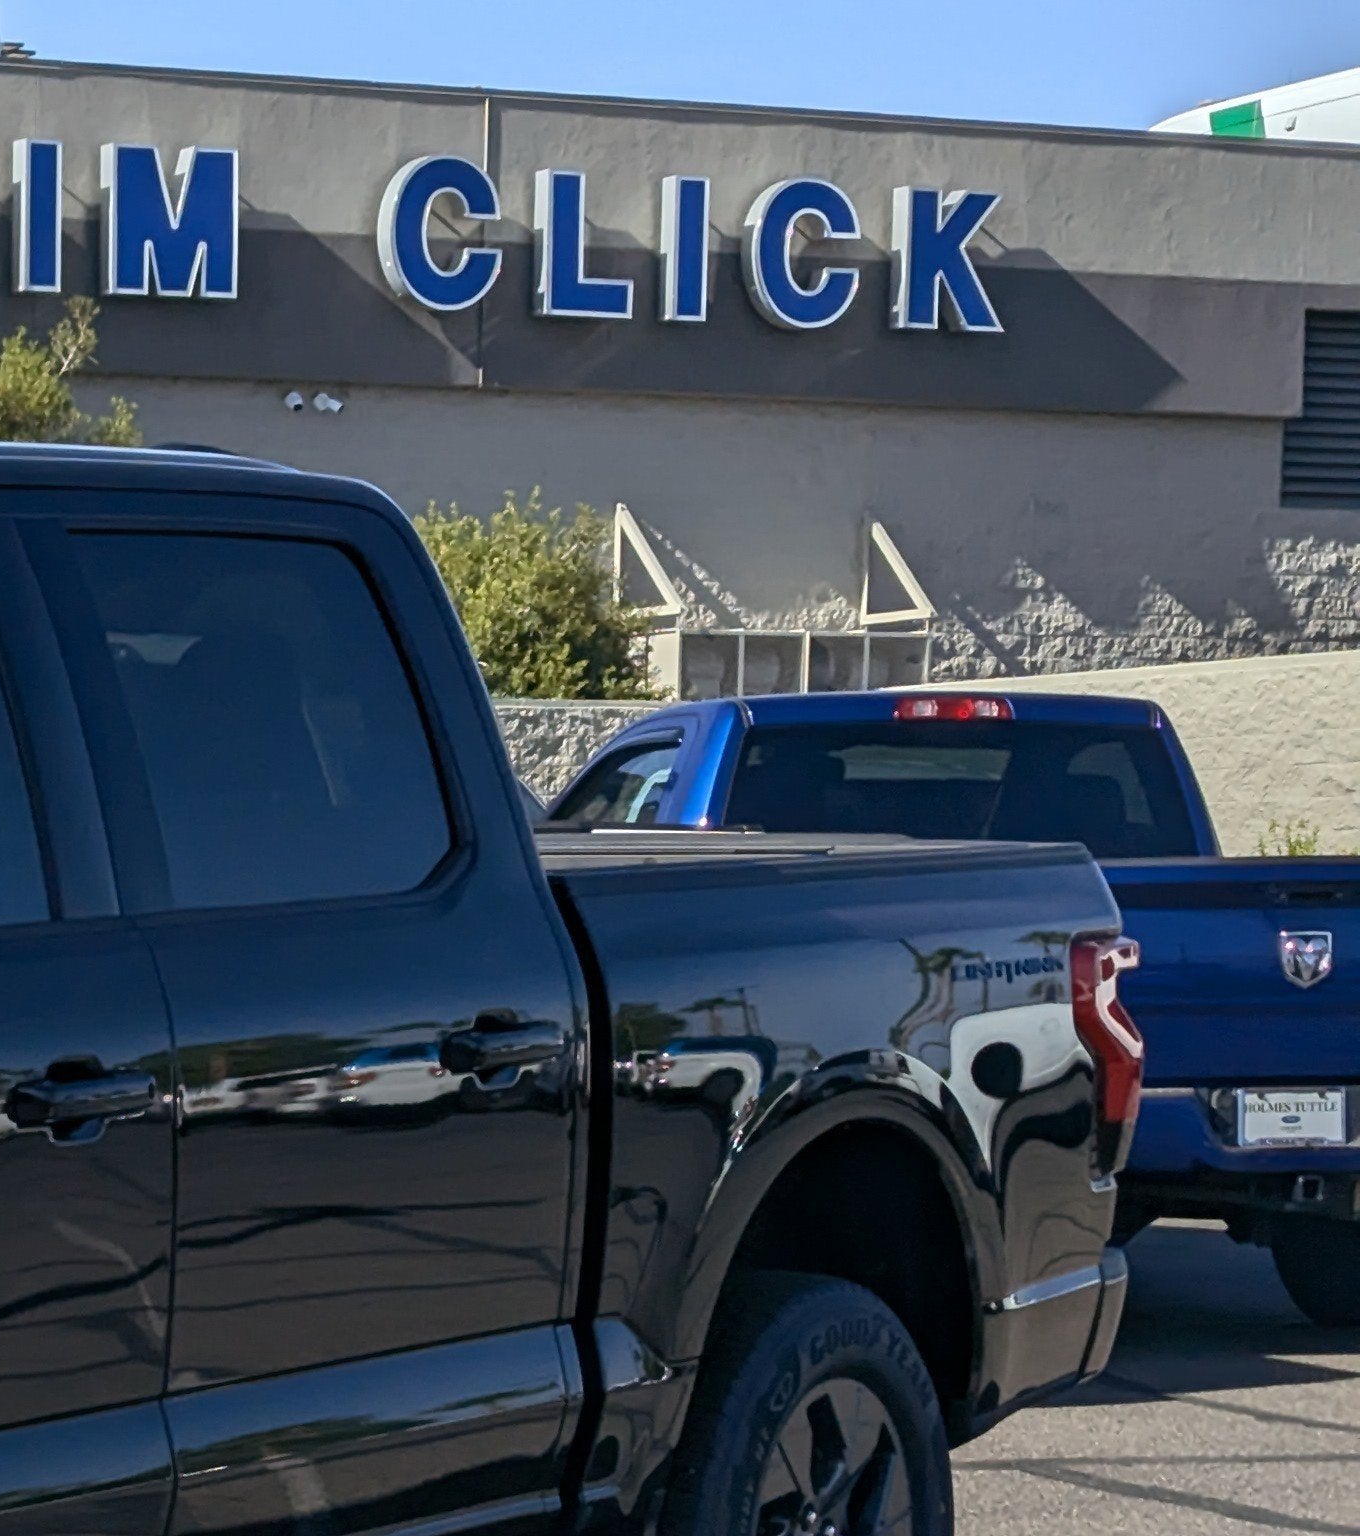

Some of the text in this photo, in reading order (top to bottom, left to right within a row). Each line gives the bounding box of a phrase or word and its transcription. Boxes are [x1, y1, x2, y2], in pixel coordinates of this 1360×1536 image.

[377, 154, 1006, 334] CLICK
[1245, 1101, 1338, 1113] HOLMES TUTTLE
